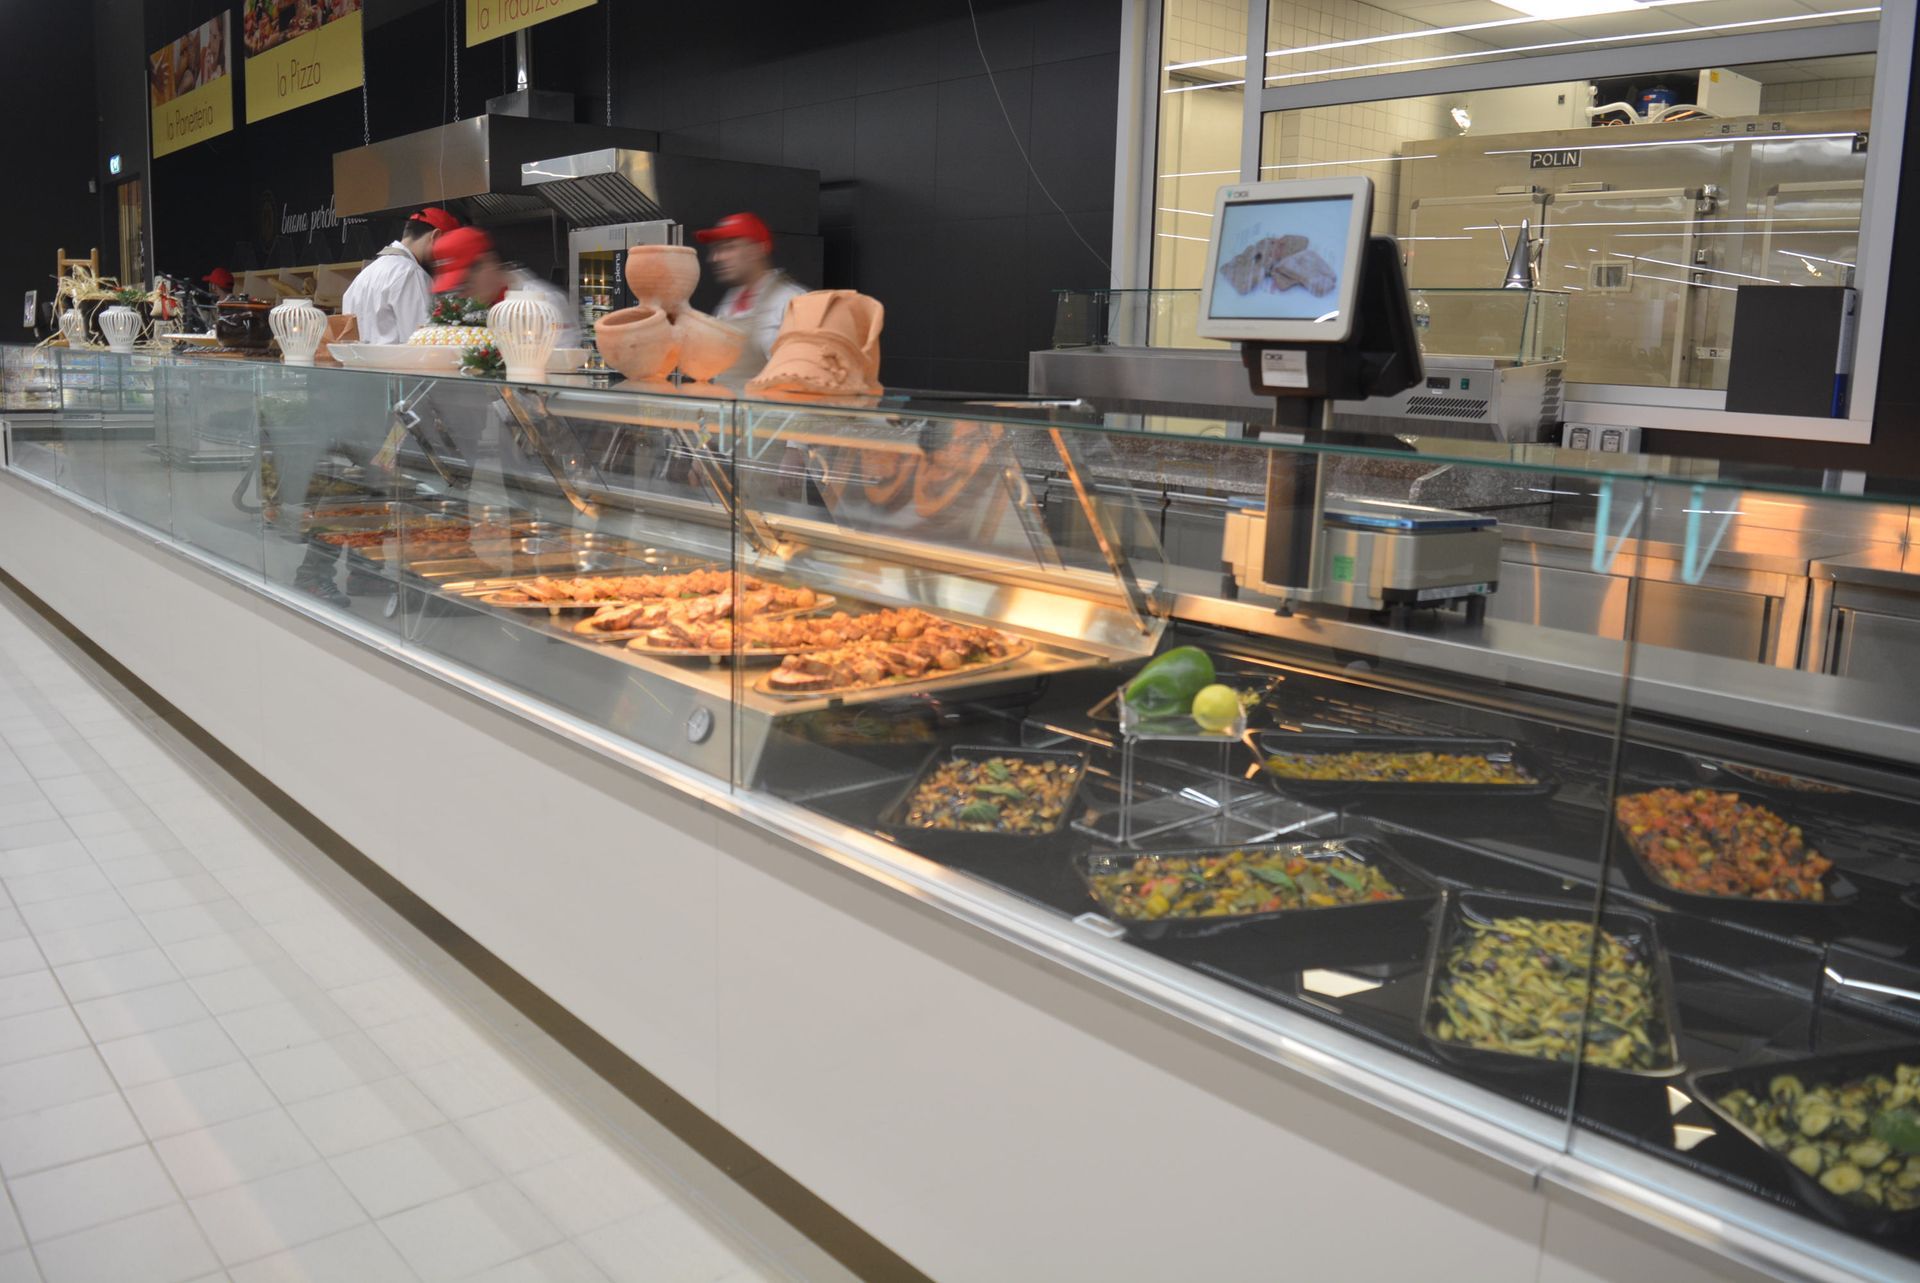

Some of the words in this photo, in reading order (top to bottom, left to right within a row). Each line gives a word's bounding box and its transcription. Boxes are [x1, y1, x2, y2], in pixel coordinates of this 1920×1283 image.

[276, 62, 288, 98] la
[289, 59, 321, 94] Pizza
[166, 111, 175, 142] la
[1532, 151, 1578, 167] POLIN
